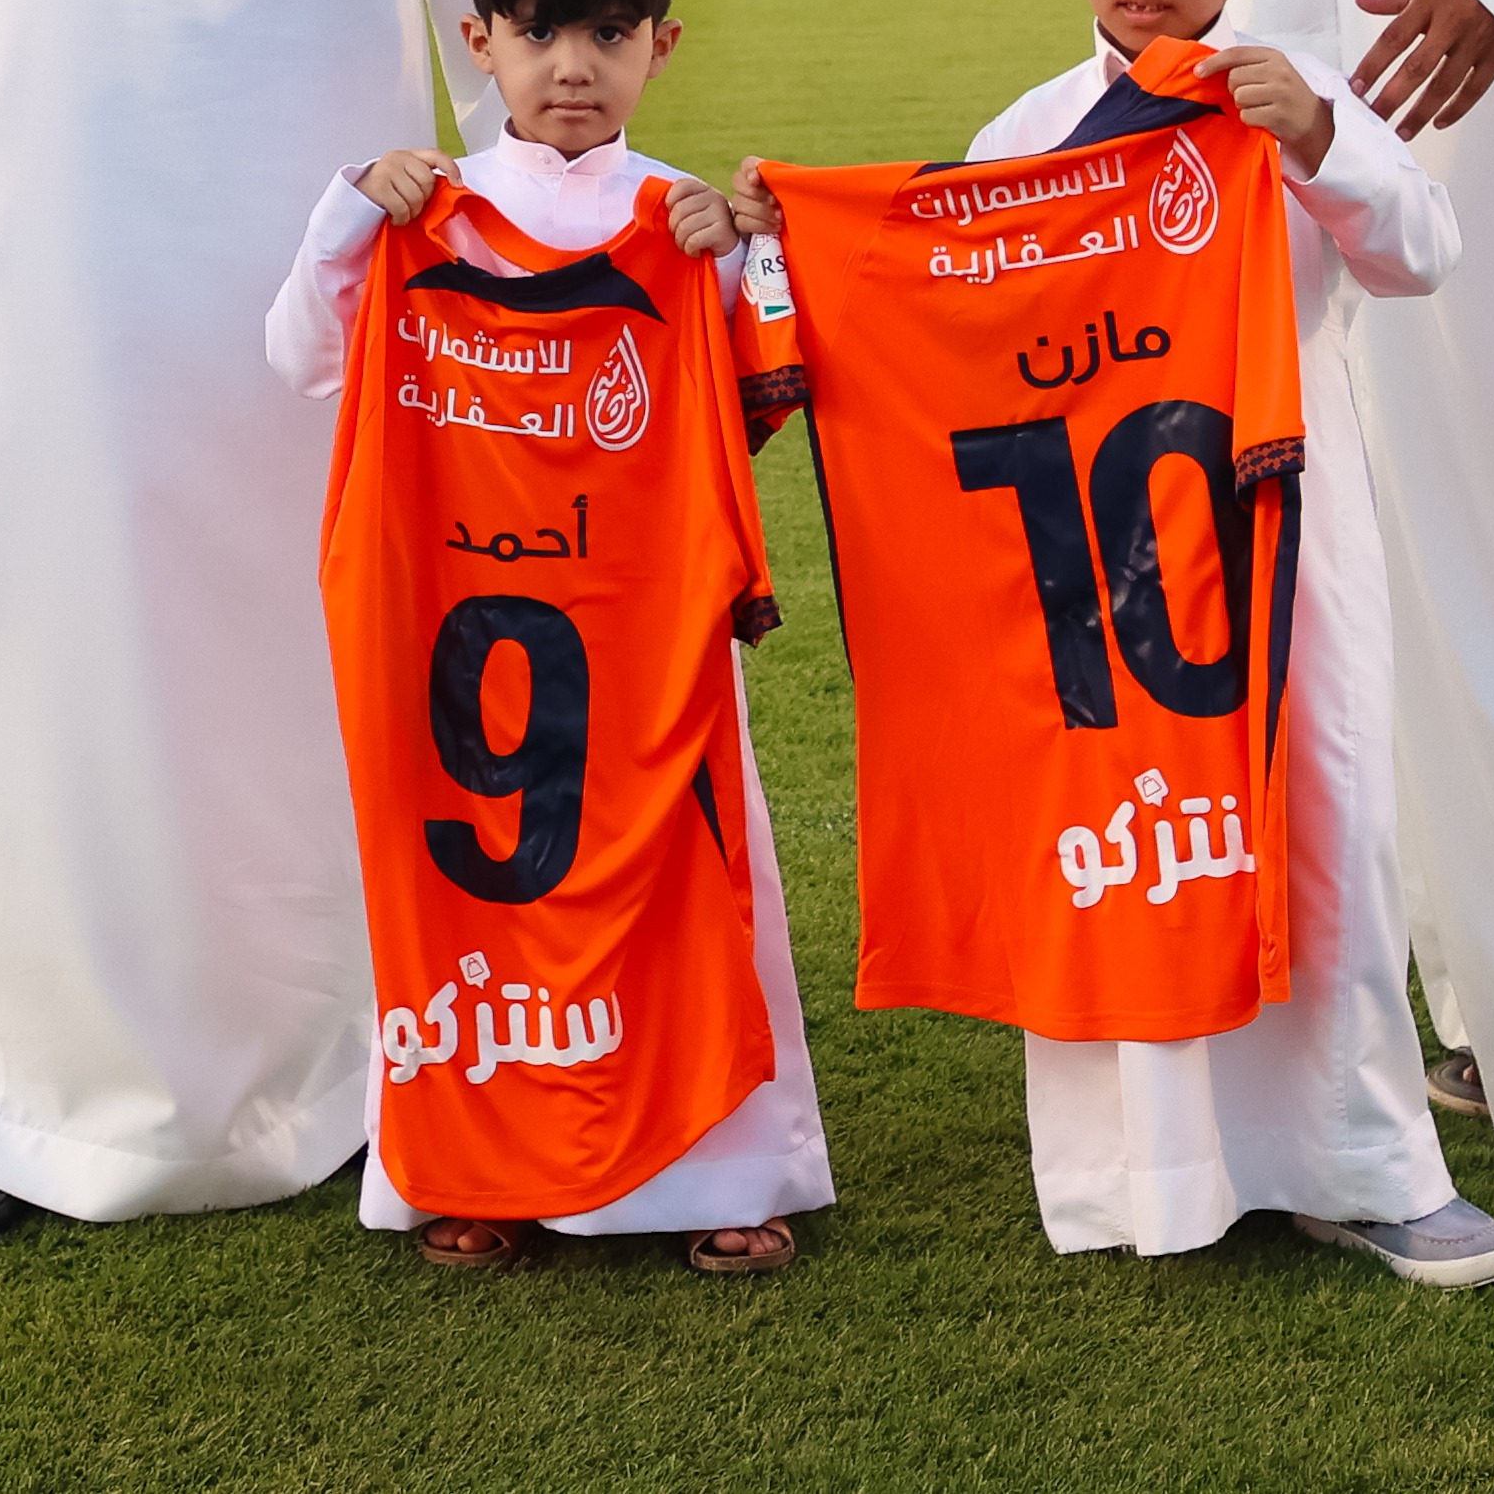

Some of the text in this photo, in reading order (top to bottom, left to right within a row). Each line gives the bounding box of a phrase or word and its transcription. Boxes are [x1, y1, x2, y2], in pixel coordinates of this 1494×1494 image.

[929, 214, 1140, 284] العقارية
[397, 308, 572, 374] للاستثمارات
[1016, 310, 1172, 389] مازن
[398, 374, 574, 438] العقارية
[445, 493, 589, 562] أحمد
[950, 399, 1252, 731] 10
[424, 595, 590, 904] 9
[1057, 793, 1256, 909] نتركو
